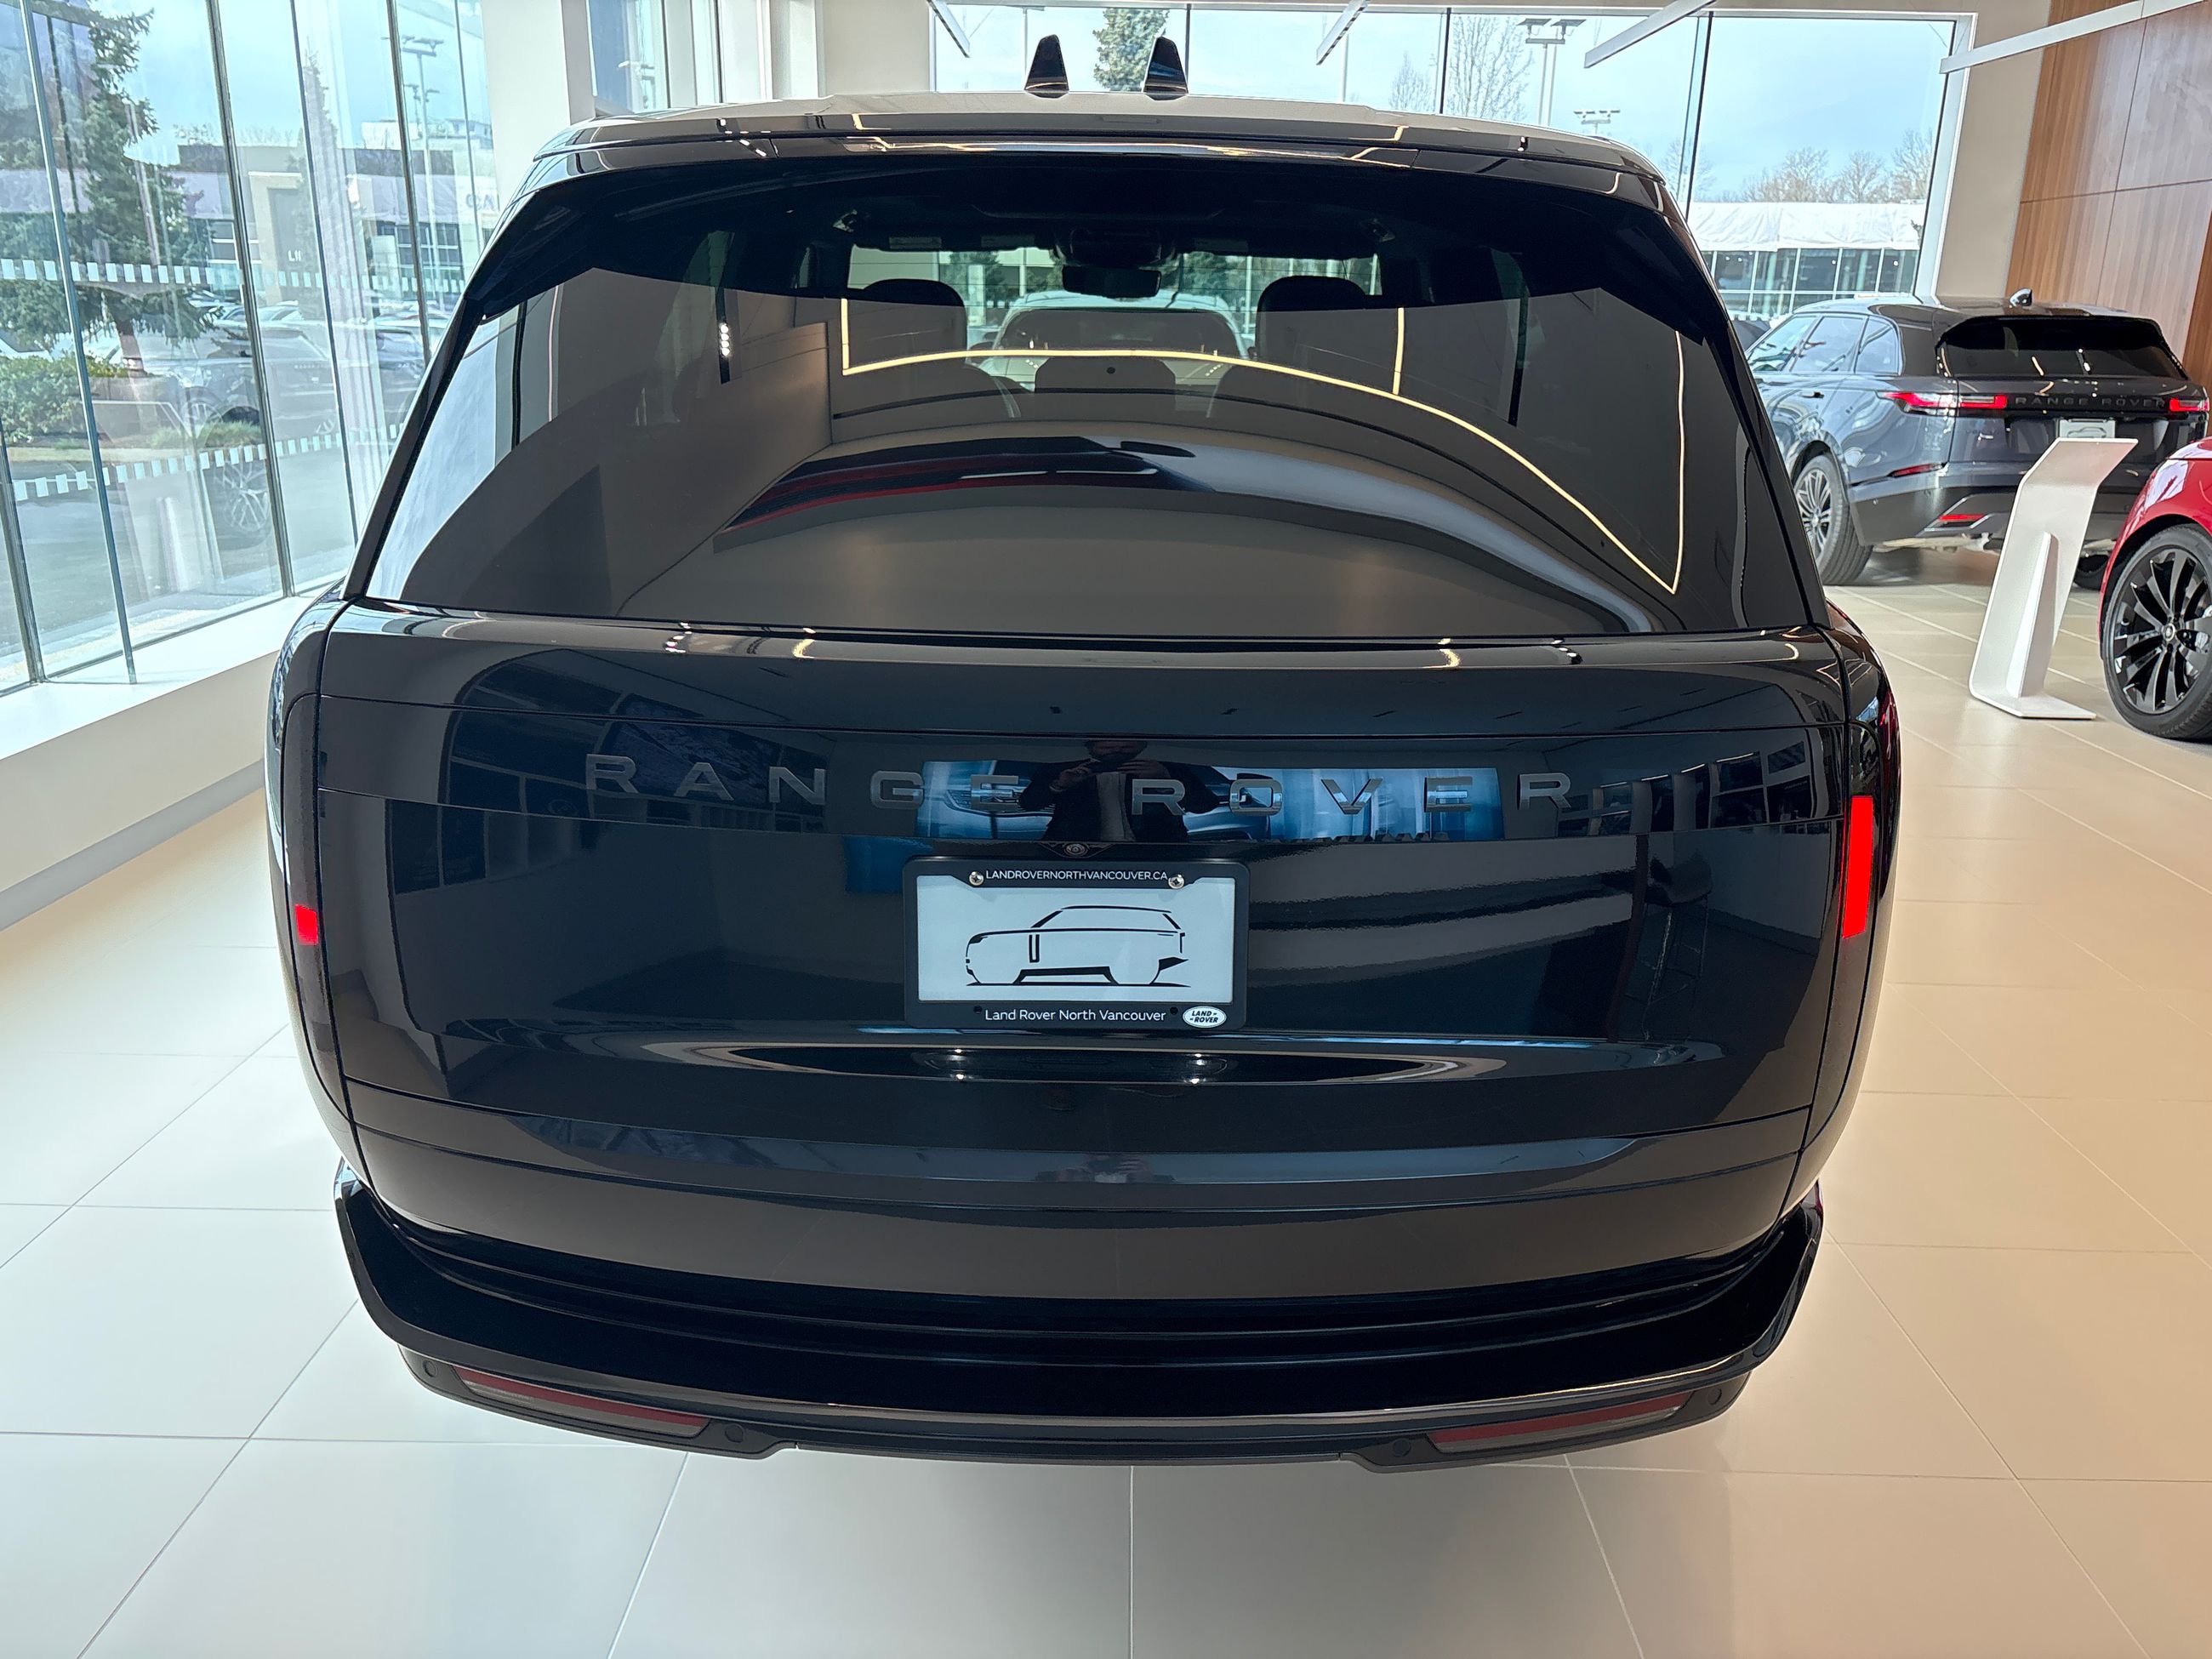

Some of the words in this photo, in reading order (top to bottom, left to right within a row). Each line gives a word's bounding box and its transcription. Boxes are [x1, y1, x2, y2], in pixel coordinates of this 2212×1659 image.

[2015, 396, 2089, 406] RANGE
[2101, 397, 2165, 408] ROVER
[585, 753, 1020, 812] RANGE
[1131, 772, 1572, 816] ROVER
[985, 870, 1168, 881] LANDROVERNORTHVANCOUVER.CA
[985, 1009, 1017, 1020] Land
[1019, 1009, 1056, 1021] Rover
[1059, 1009, 1097, 1021] North
[1099, 1010, 1166, 1021] Vancouver
